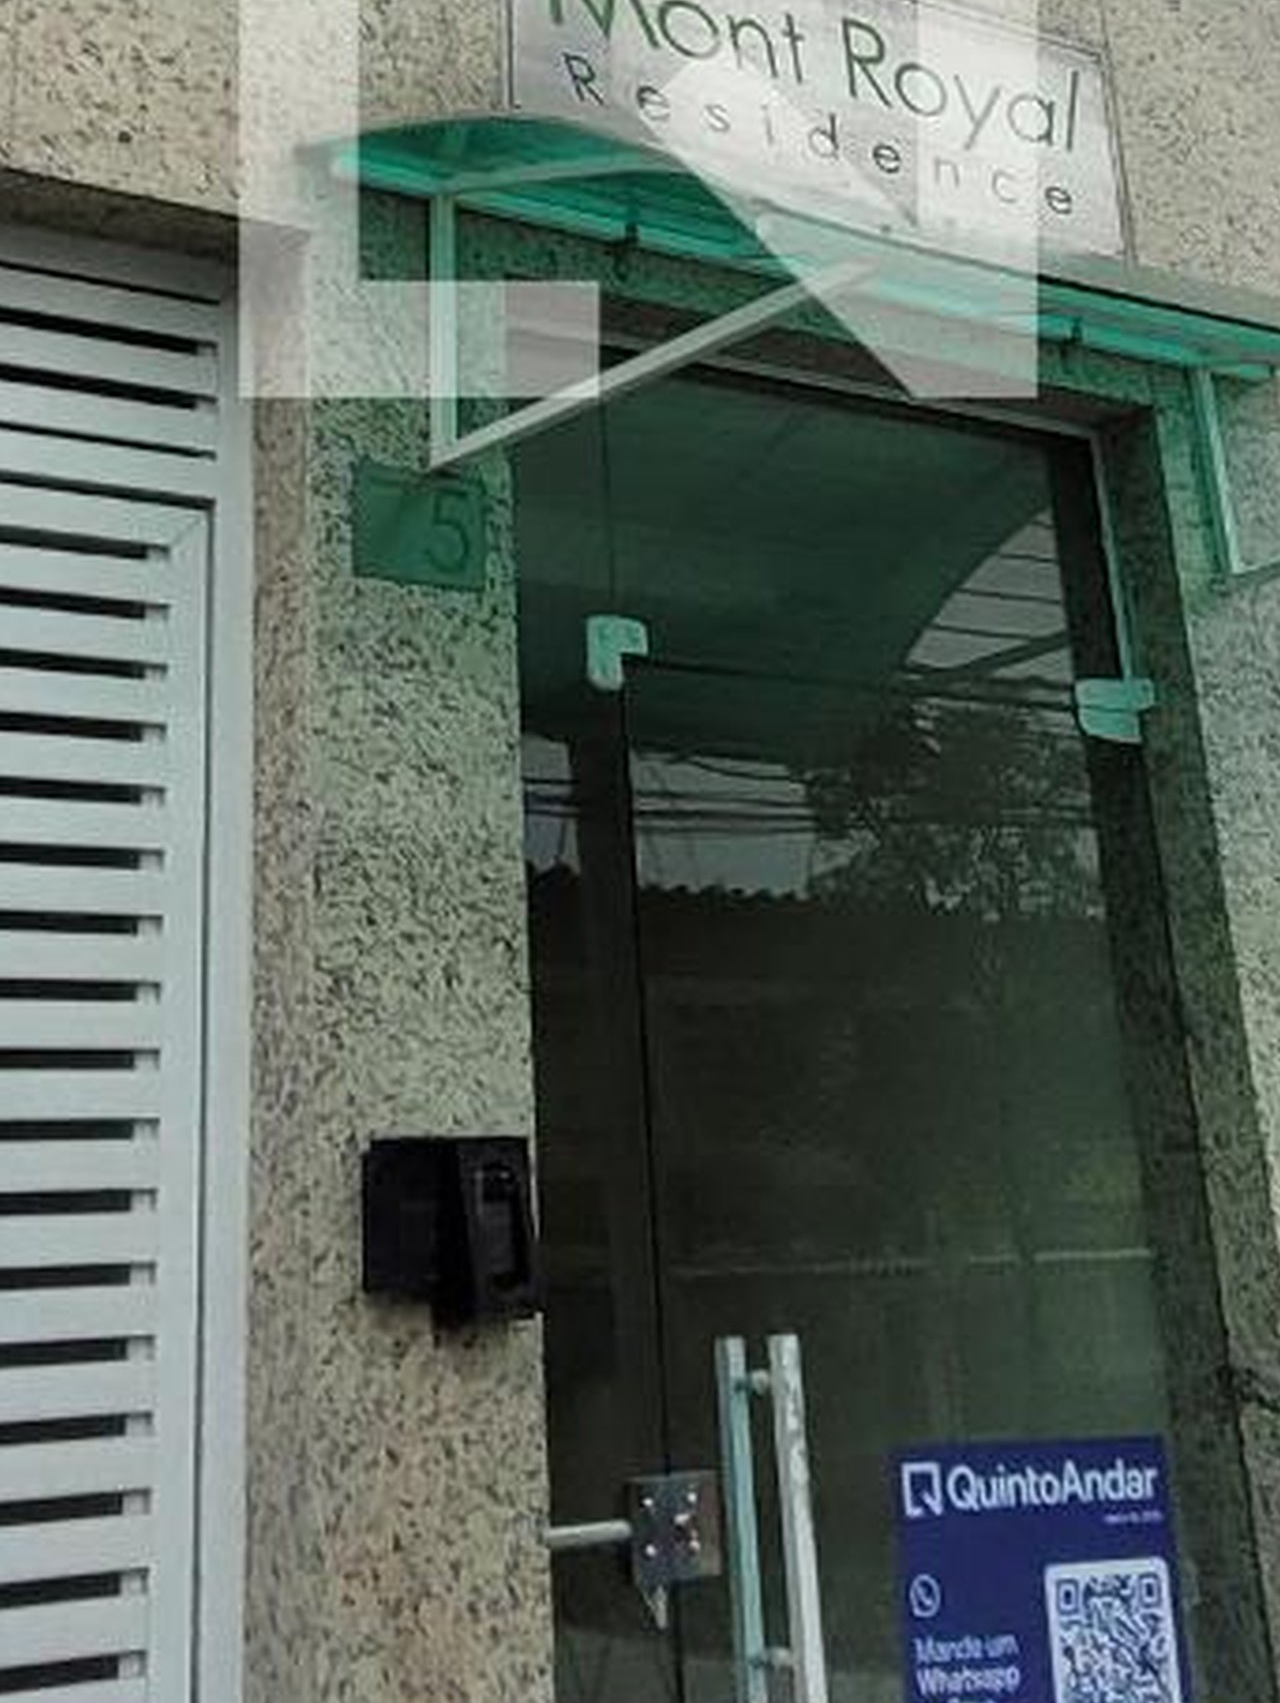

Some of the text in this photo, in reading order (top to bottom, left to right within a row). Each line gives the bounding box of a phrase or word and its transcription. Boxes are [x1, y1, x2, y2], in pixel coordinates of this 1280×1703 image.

[562, 51, 1074, 215] Residence
[841, 16, 1080, 152] Royal
[946, 1458, 1158, 1512] QuintoAndar
